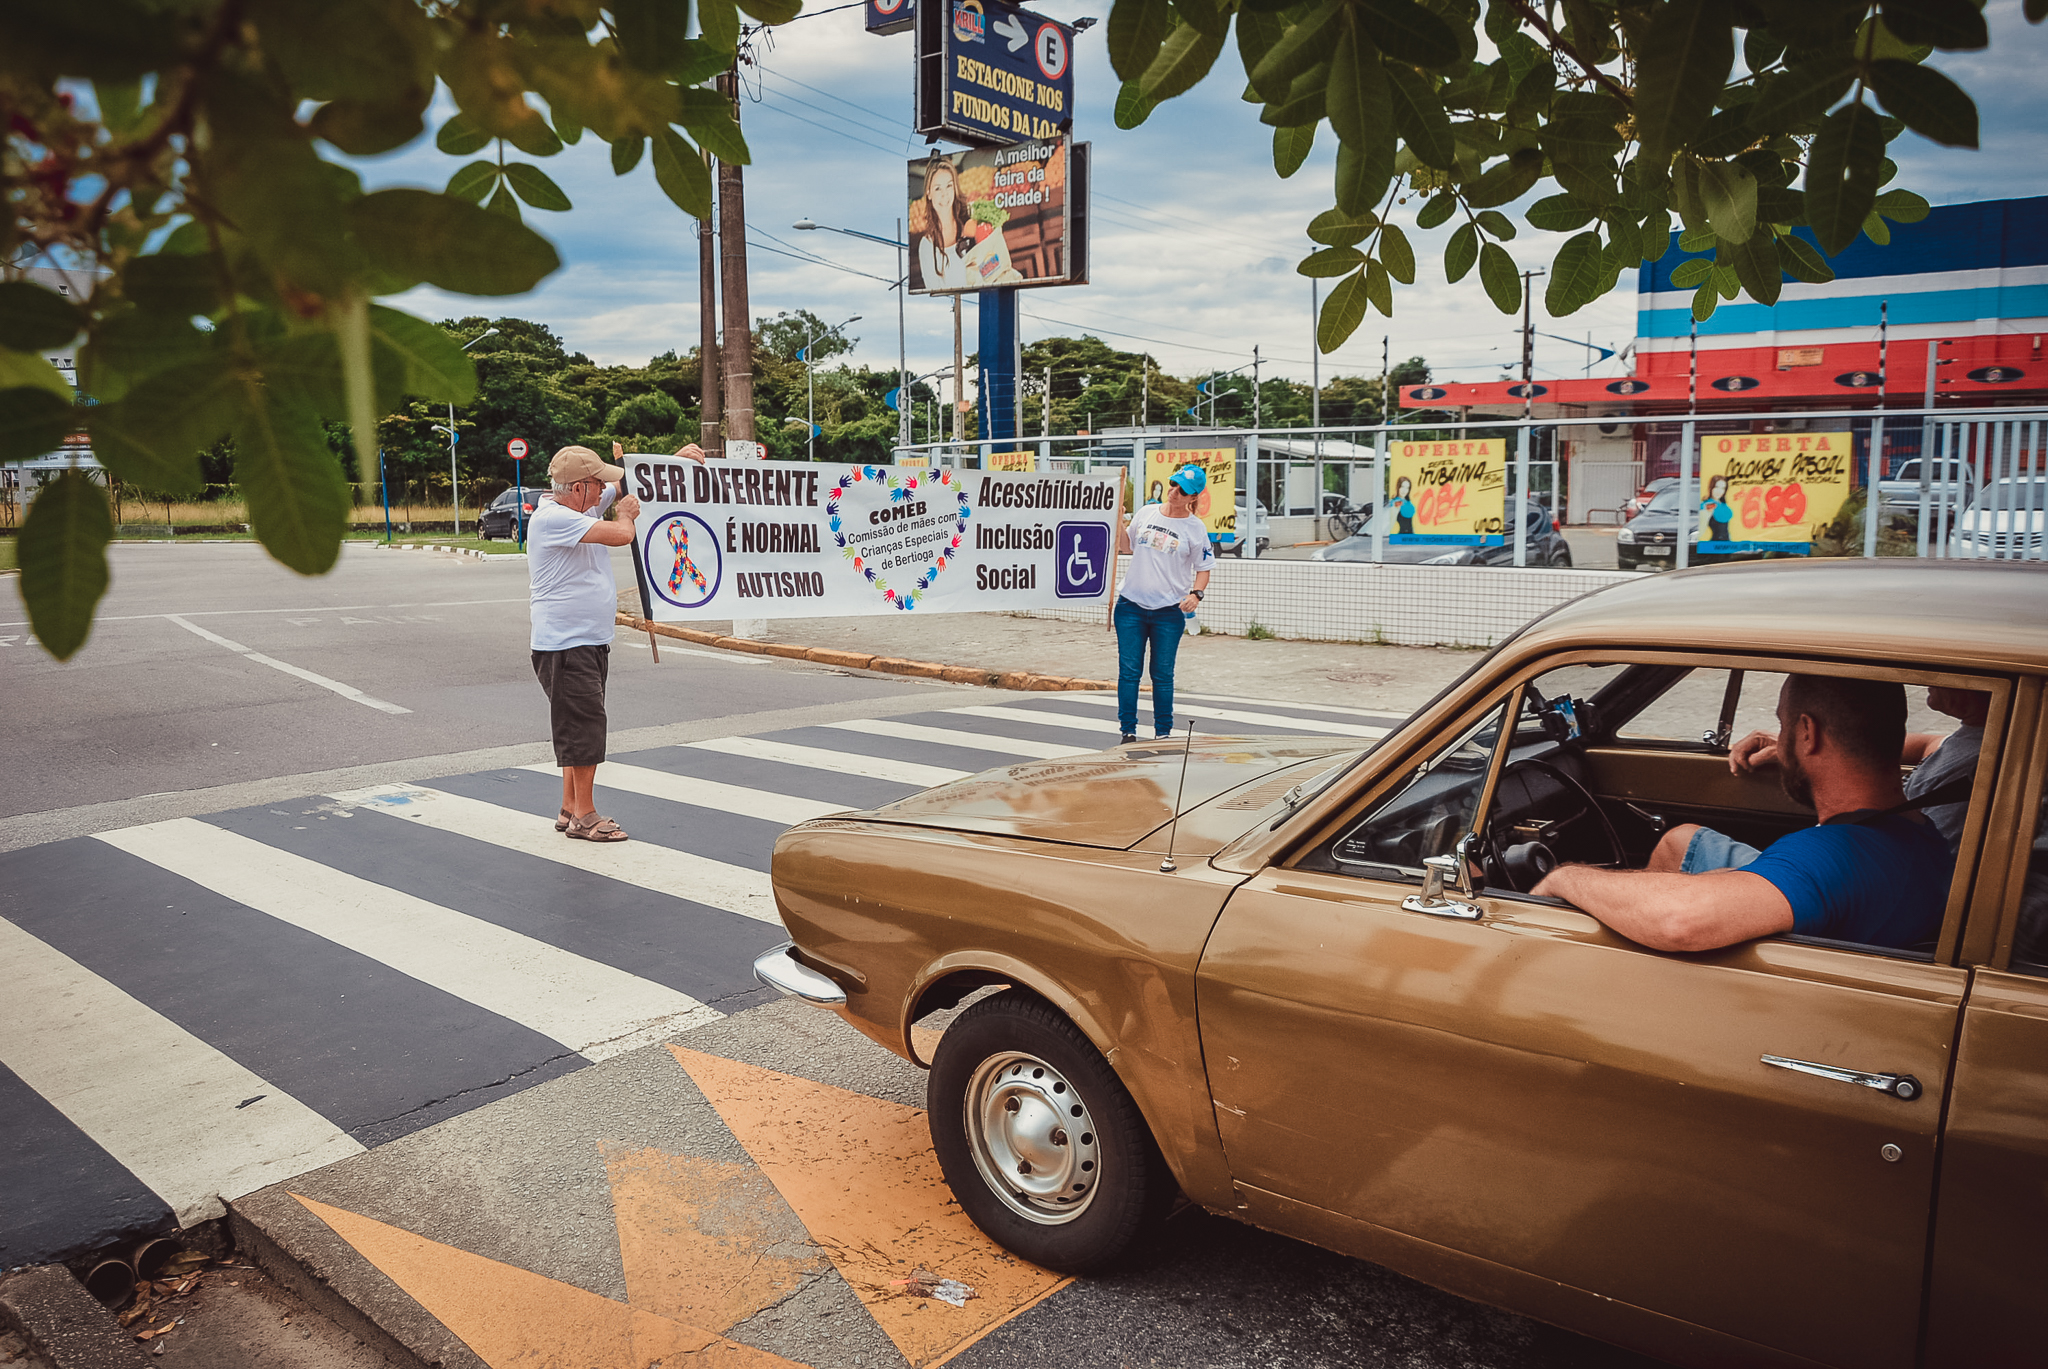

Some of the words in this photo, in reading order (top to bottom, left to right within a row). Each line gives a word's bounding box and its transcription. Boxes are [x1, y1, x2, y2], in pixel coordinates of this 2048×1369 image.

[954, 9, 985, 35] KRILL
[1046, 36, 1057, 66] E
[957, 55, 1034, 102] ESTACIONE
[1037, 83, 1064, 112] NOS
[952, 90, 1010, 127] FUNDOS
[1012, 110, 1031, 137] DA
[994, 149, 1005, 166] A
[1007, 144, 1055, 164] melhor
[994, 170, 1025, 188] feira
[1027, 166, 1045, 183] da
[994, 188, 1042, 209] Cidade
[1156, 451, 1224, 463] OFERTA
[1403, 443, 1490, 457] OFERTA
[1718, 437, 1831, 453] OFERTA
[992, 454, 1028, 465] OFERTA
[1725, 458, 1786, 479] COLOMBA
[1791, 453, 1846, 475] PASCAL
[634, 463, 687, 503] SER
[692, 465, 819, 507] DIFERENTE
[977, 476, 1114, 511] Acessibilidade
[869, 501, 927, 525] COMEB
[725, 516, 737, 553] É
[741, 522, 821, 554] NORMAL
[848, 525, 895, 545] Comissão
[897, 521, 909, 533] de
[911, 516, 936, 531] mães
[938, 512, 957, 525] com
[976, 522, 1054, 550] Inclusão
[861, 540, 903, 558] Crianças
[905, 529, 949, 549] Especiais
[881, 558, 893, 570] de
[895, 549, 934, 566] Bertioga
[736, 571, 825, 598] AUTISMO
[976, 563, 1036, 590] Social
